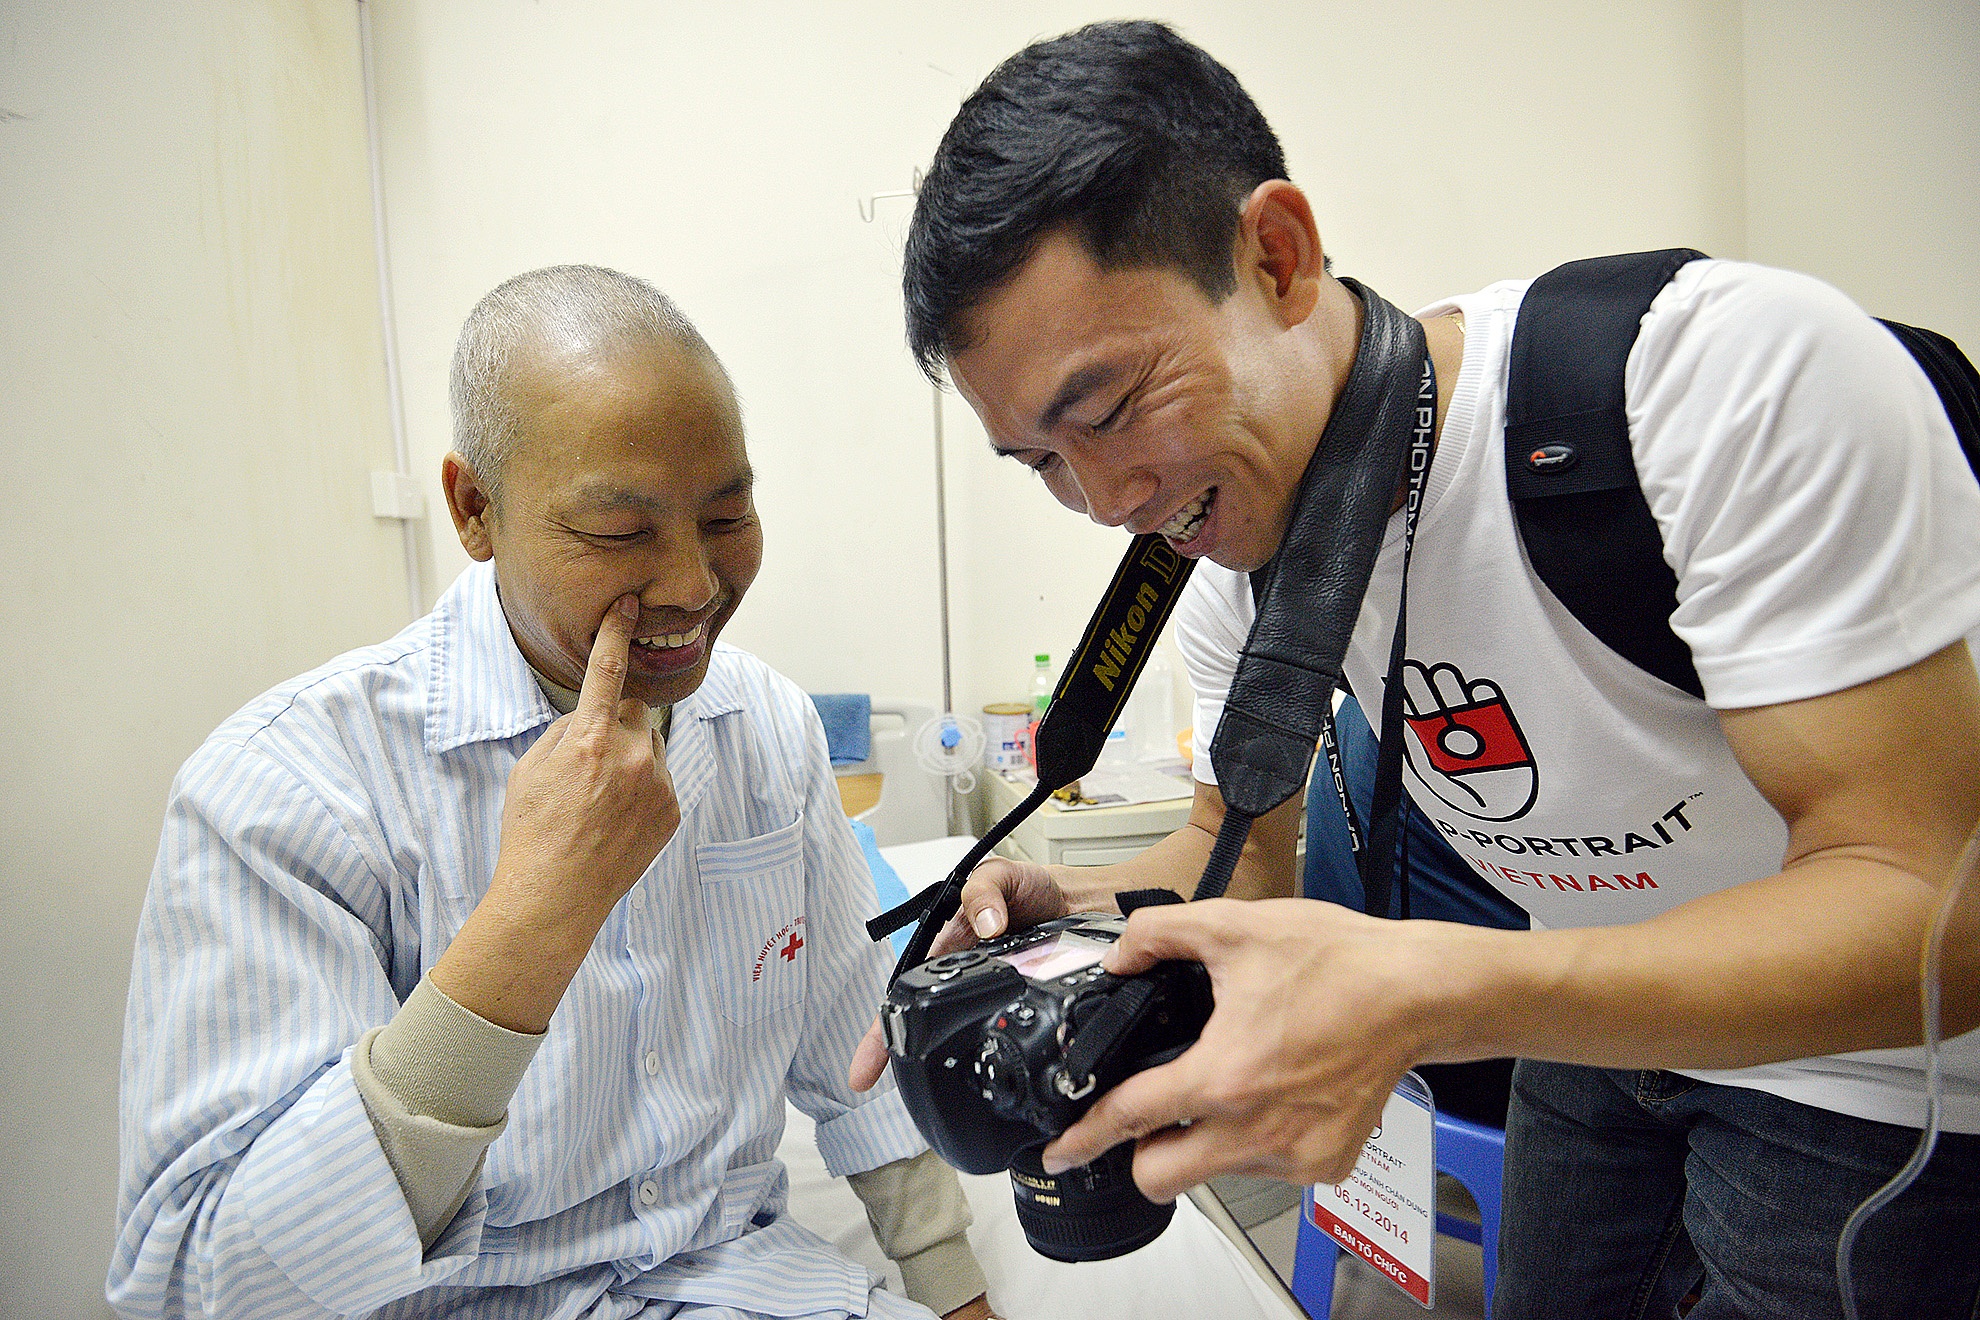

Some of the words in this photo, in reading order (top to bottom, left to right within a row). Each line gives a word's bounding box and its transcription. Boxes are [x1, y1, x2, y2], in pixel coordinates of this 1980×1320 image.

[1093, 582, 1159, 692] Nikon
[1436, 800, 1692, 857] P-PORTRAIT
[1466, 854, 1659, 892] VIETNAM
[1361, 1150, 1391, 1173] ETNAM
[1365, 1141, 1402, 1169] ORTRAIT
[1335, 1184, 1409, 1244] 06.12.2014
[1333, 1224, 1356, 1247] BAN
